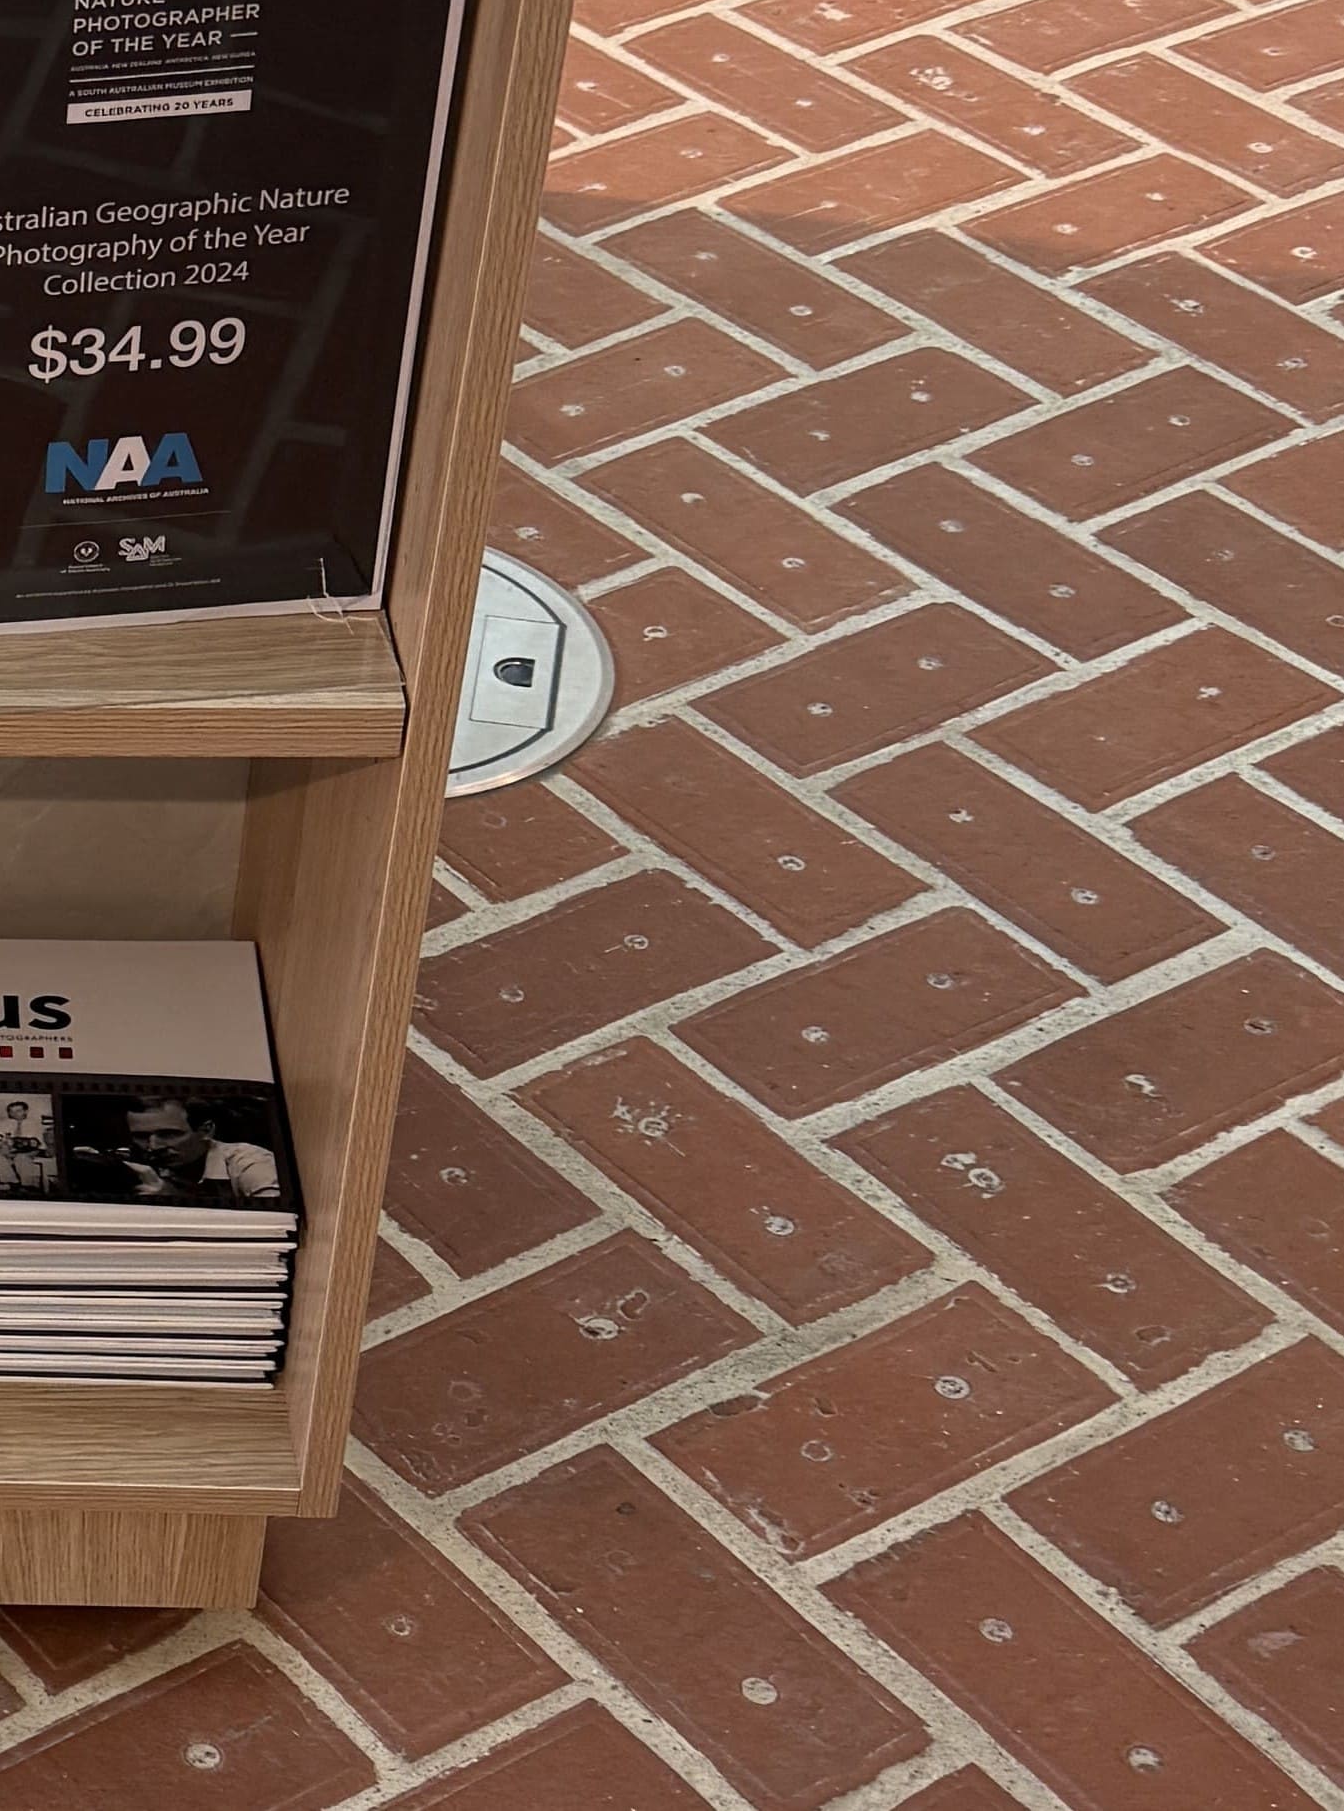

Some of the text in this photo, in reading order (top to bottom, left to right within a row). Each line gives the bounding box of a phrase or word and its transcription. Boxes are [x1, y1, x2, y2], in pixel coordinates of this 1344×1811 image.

[72, 3, 261, 34] PHOTOGRAPHER
[72, 30, 222, 57] OF THE YEAR
[85, 96, 234, 118] CELEBRATING 20 YEARS
[95, 191, 252, 226] Geographic
[258, 186, 350, 213] Nature
[168, 229, 198, 254] of
[203, 226, 248, 251] the
[253, 222, 311, 247] Year
[42, 259, 249, 297] Collection 2024
[28, 316, 247, 384] $34.99
[44, 431, 204, 493] NAA
